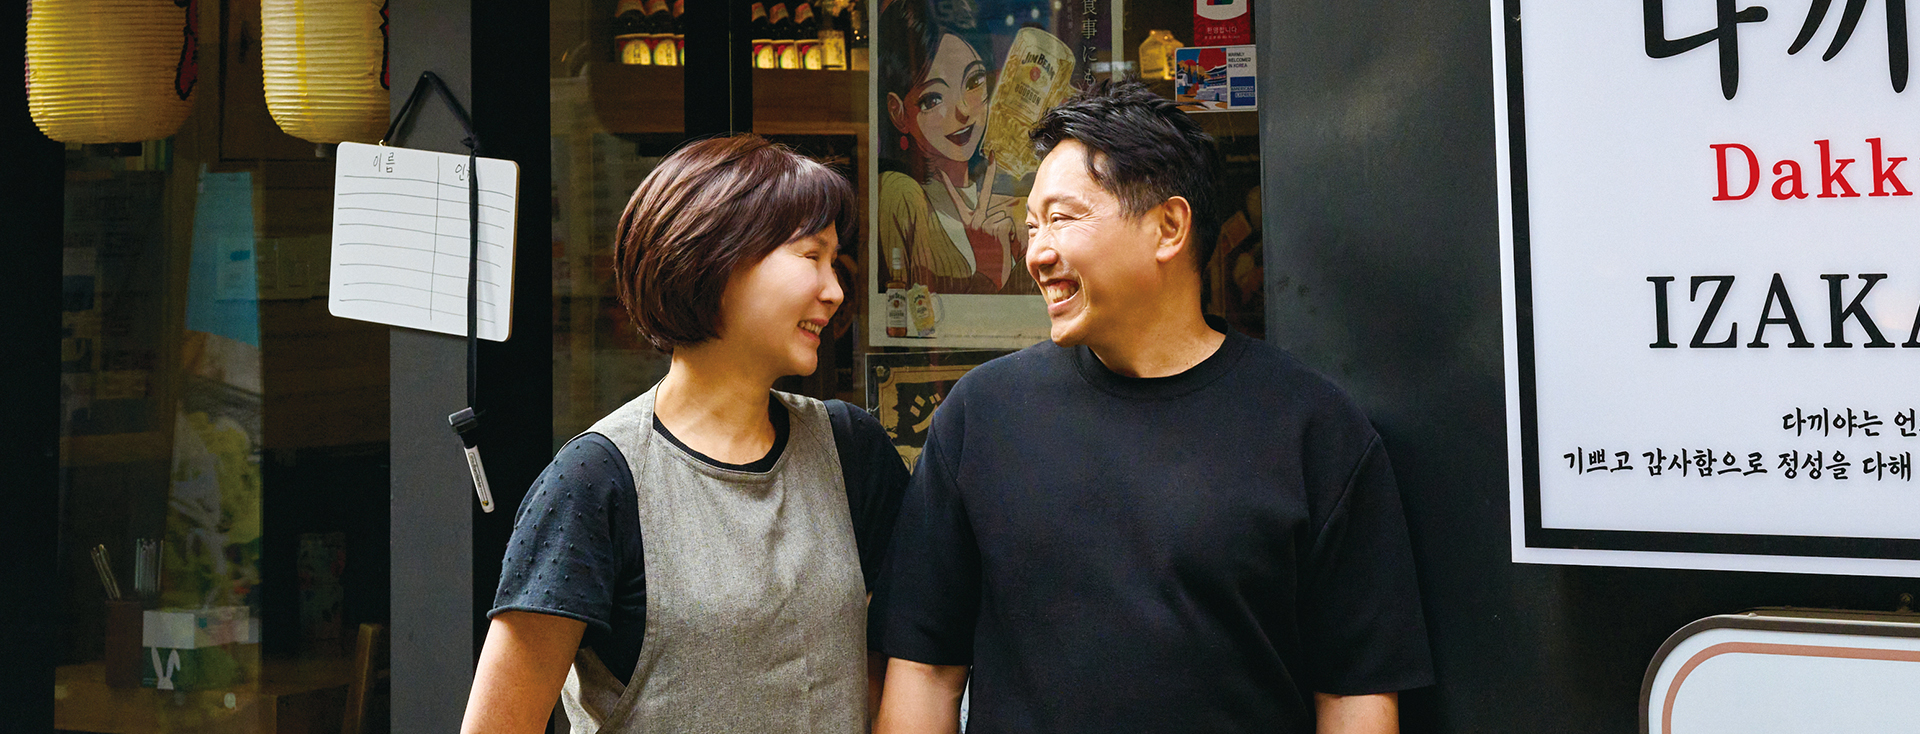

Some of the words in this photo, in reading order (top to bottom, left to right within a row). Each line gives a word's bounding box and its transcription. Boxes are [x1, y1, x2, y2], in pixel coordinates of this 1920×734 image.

[373, 152, 396, 173] 이름
[455, 163, 471, 182] 인
[1709, 138, 1920, 201] Dakk
[1646, 273, 1920, 348] IZAK
[1782, 408, 1884, 437] 다끼야는
[1894, 408, 1920, 437] 언
[1563, 447, 1634, 475] 기쁘고
[1642, 448, 1768, 477] 감사함으로
[1777, 450, 1852, 480] 정성을
[1862, 450, 1912, 482] 다해
